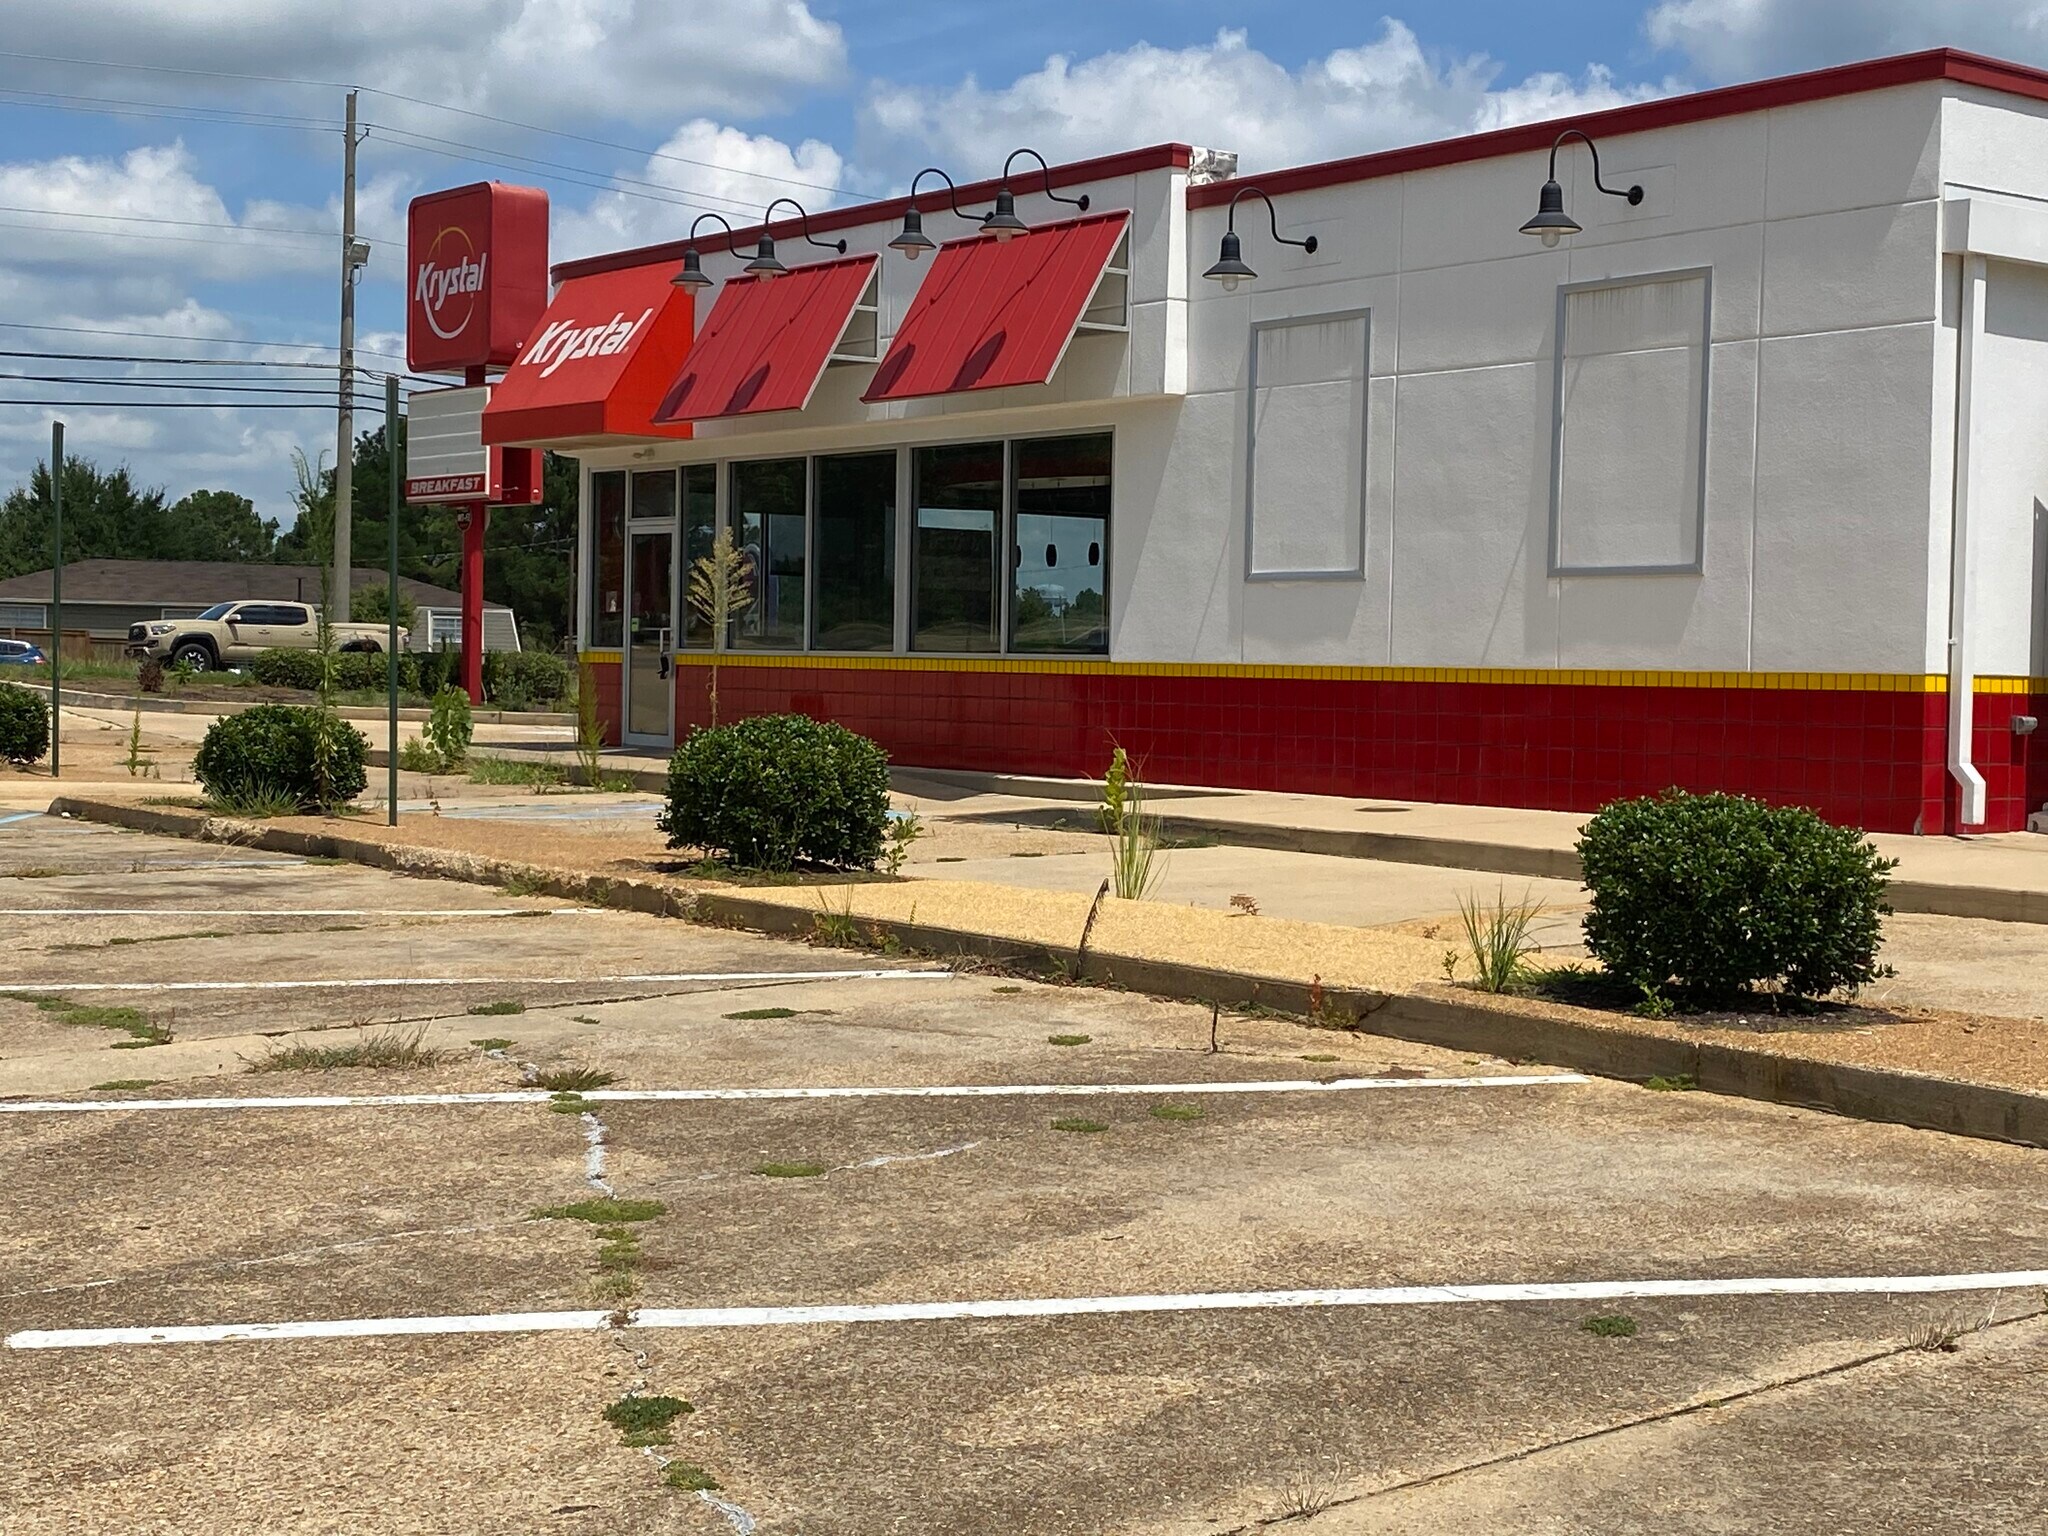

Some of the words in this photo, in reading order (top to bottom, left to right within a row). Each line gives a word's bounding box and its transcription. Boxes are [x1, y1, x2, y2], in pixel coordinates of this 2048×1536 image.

[415, 252, 487, 311] Krystal
[520, 308, 653, 378] Krystal
[410, 477, 481, 494] BREAKFAST
